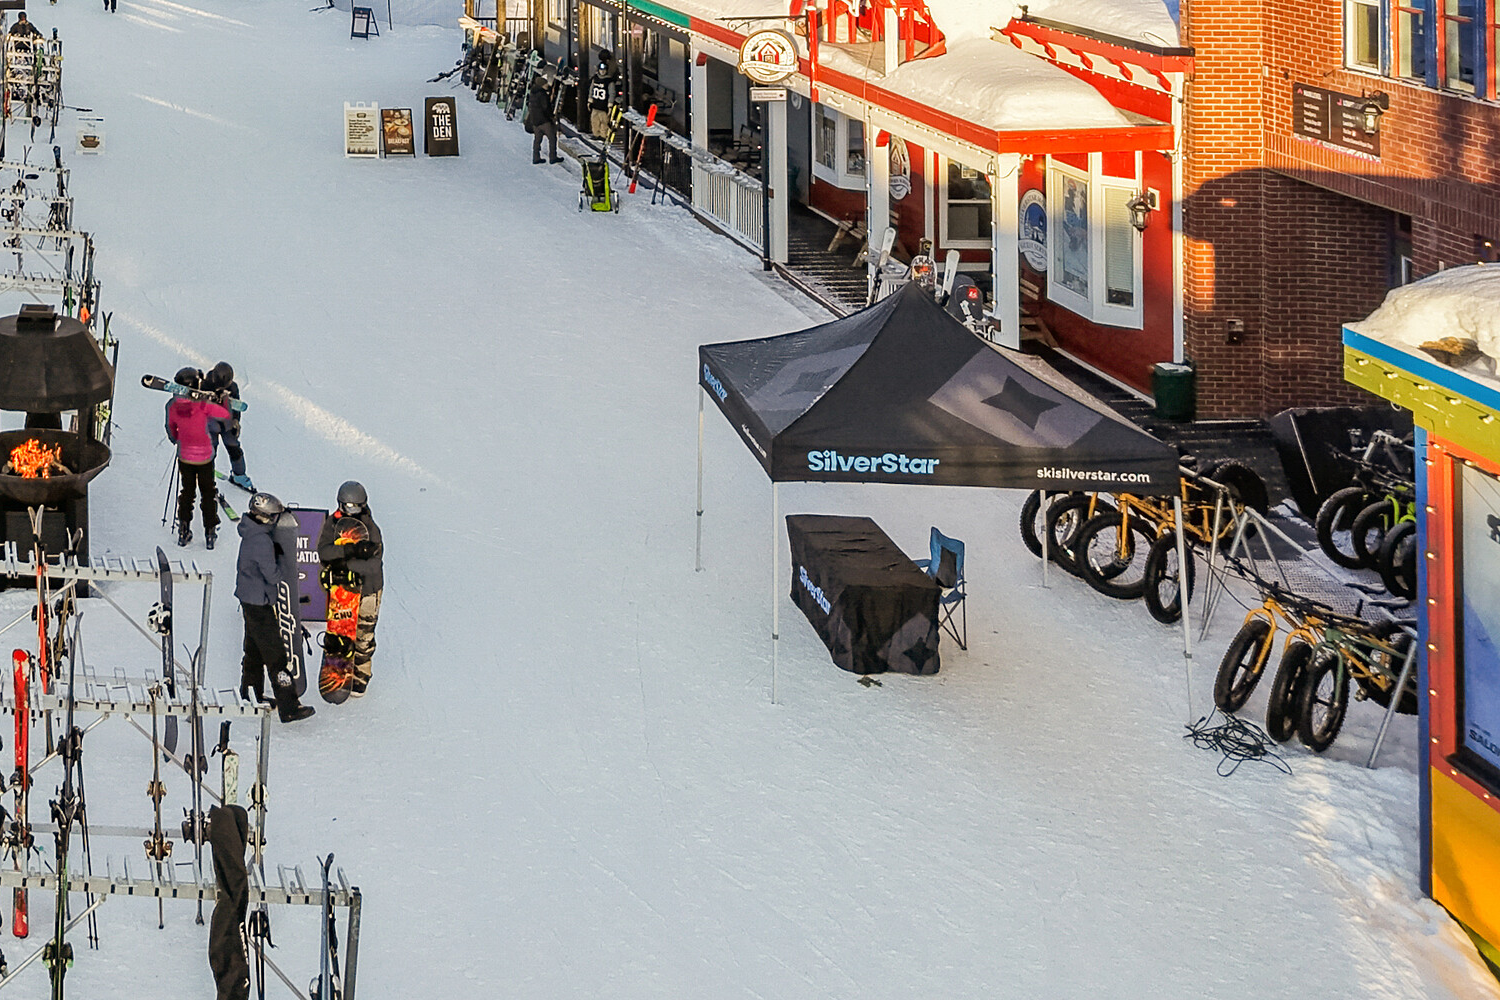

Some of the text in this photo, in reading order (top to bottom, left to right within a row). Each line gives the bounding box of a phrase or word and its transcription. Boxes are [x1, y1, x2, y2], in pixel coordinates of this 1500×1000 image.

[432, 114, 452, 126] THE
[433, 126, 453, 138] DEN
[807, 449, 1151, 483] SilverStar skisilverstar.com
